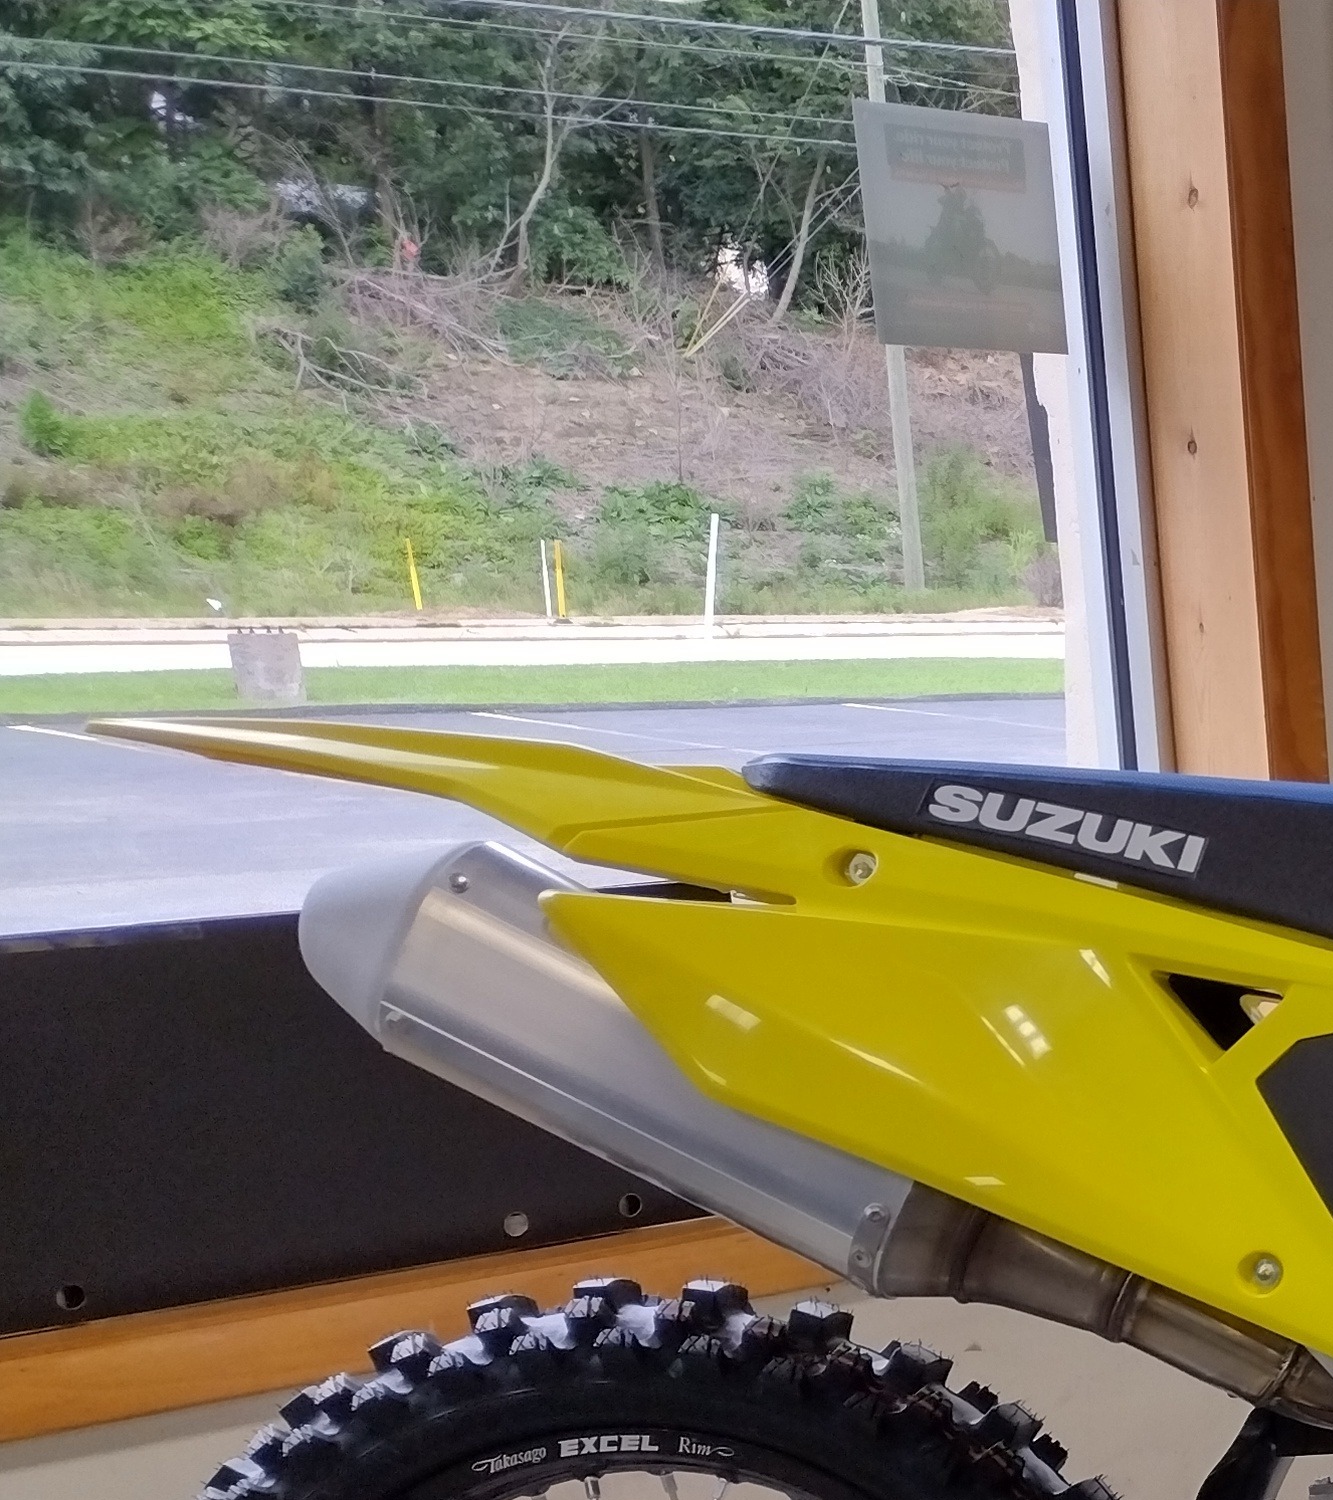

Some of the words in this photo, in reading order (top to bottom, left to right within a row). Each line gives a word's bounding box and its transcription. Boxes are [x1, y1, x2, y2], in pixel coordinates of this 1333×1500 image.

[928, 784, 1206, 874] SUZUKI
[477, 1446, 547, 1474] Takasago
[557, 1434, 660, 1458] EXCEL
[678, 1436, 723, 1457] Rim
